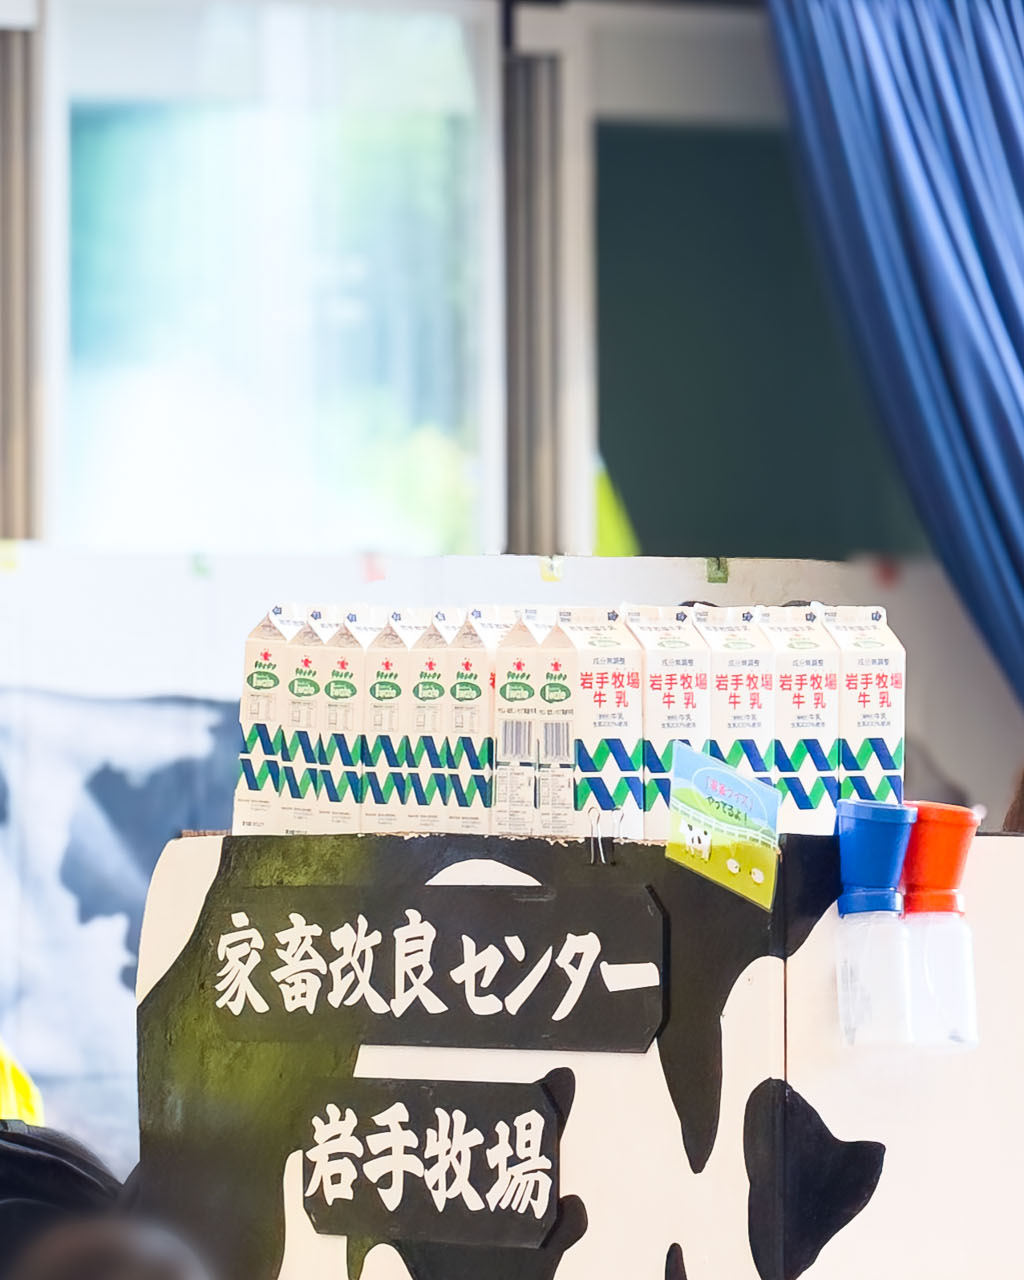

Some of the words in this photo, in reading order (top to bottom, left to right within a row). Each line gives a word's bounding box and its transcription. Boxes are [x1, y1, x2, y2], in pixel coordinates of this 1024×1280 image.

[580, 671, 640, 690] 岩手牧場
[649, 673, 707, 691] 岩手牧場
[715, 673, 773, 691] 岩手牧場
[779, 673, 837, 691] 岩手牧場
[845, 672, 903, 690] 岩手牧場
[593, 691, 629, 709] 牛乳
[662, 692, 696, 709] 牛乳
[728, 692, 762, 710] 牛乳
[792, 692, 826, 710] 牛乳
[857, 691, 892, 709] 牛乳
[214, 908, 660, 1021] 家畜改良センター
[304, 1101, 553, 1220] 岩手牧場
